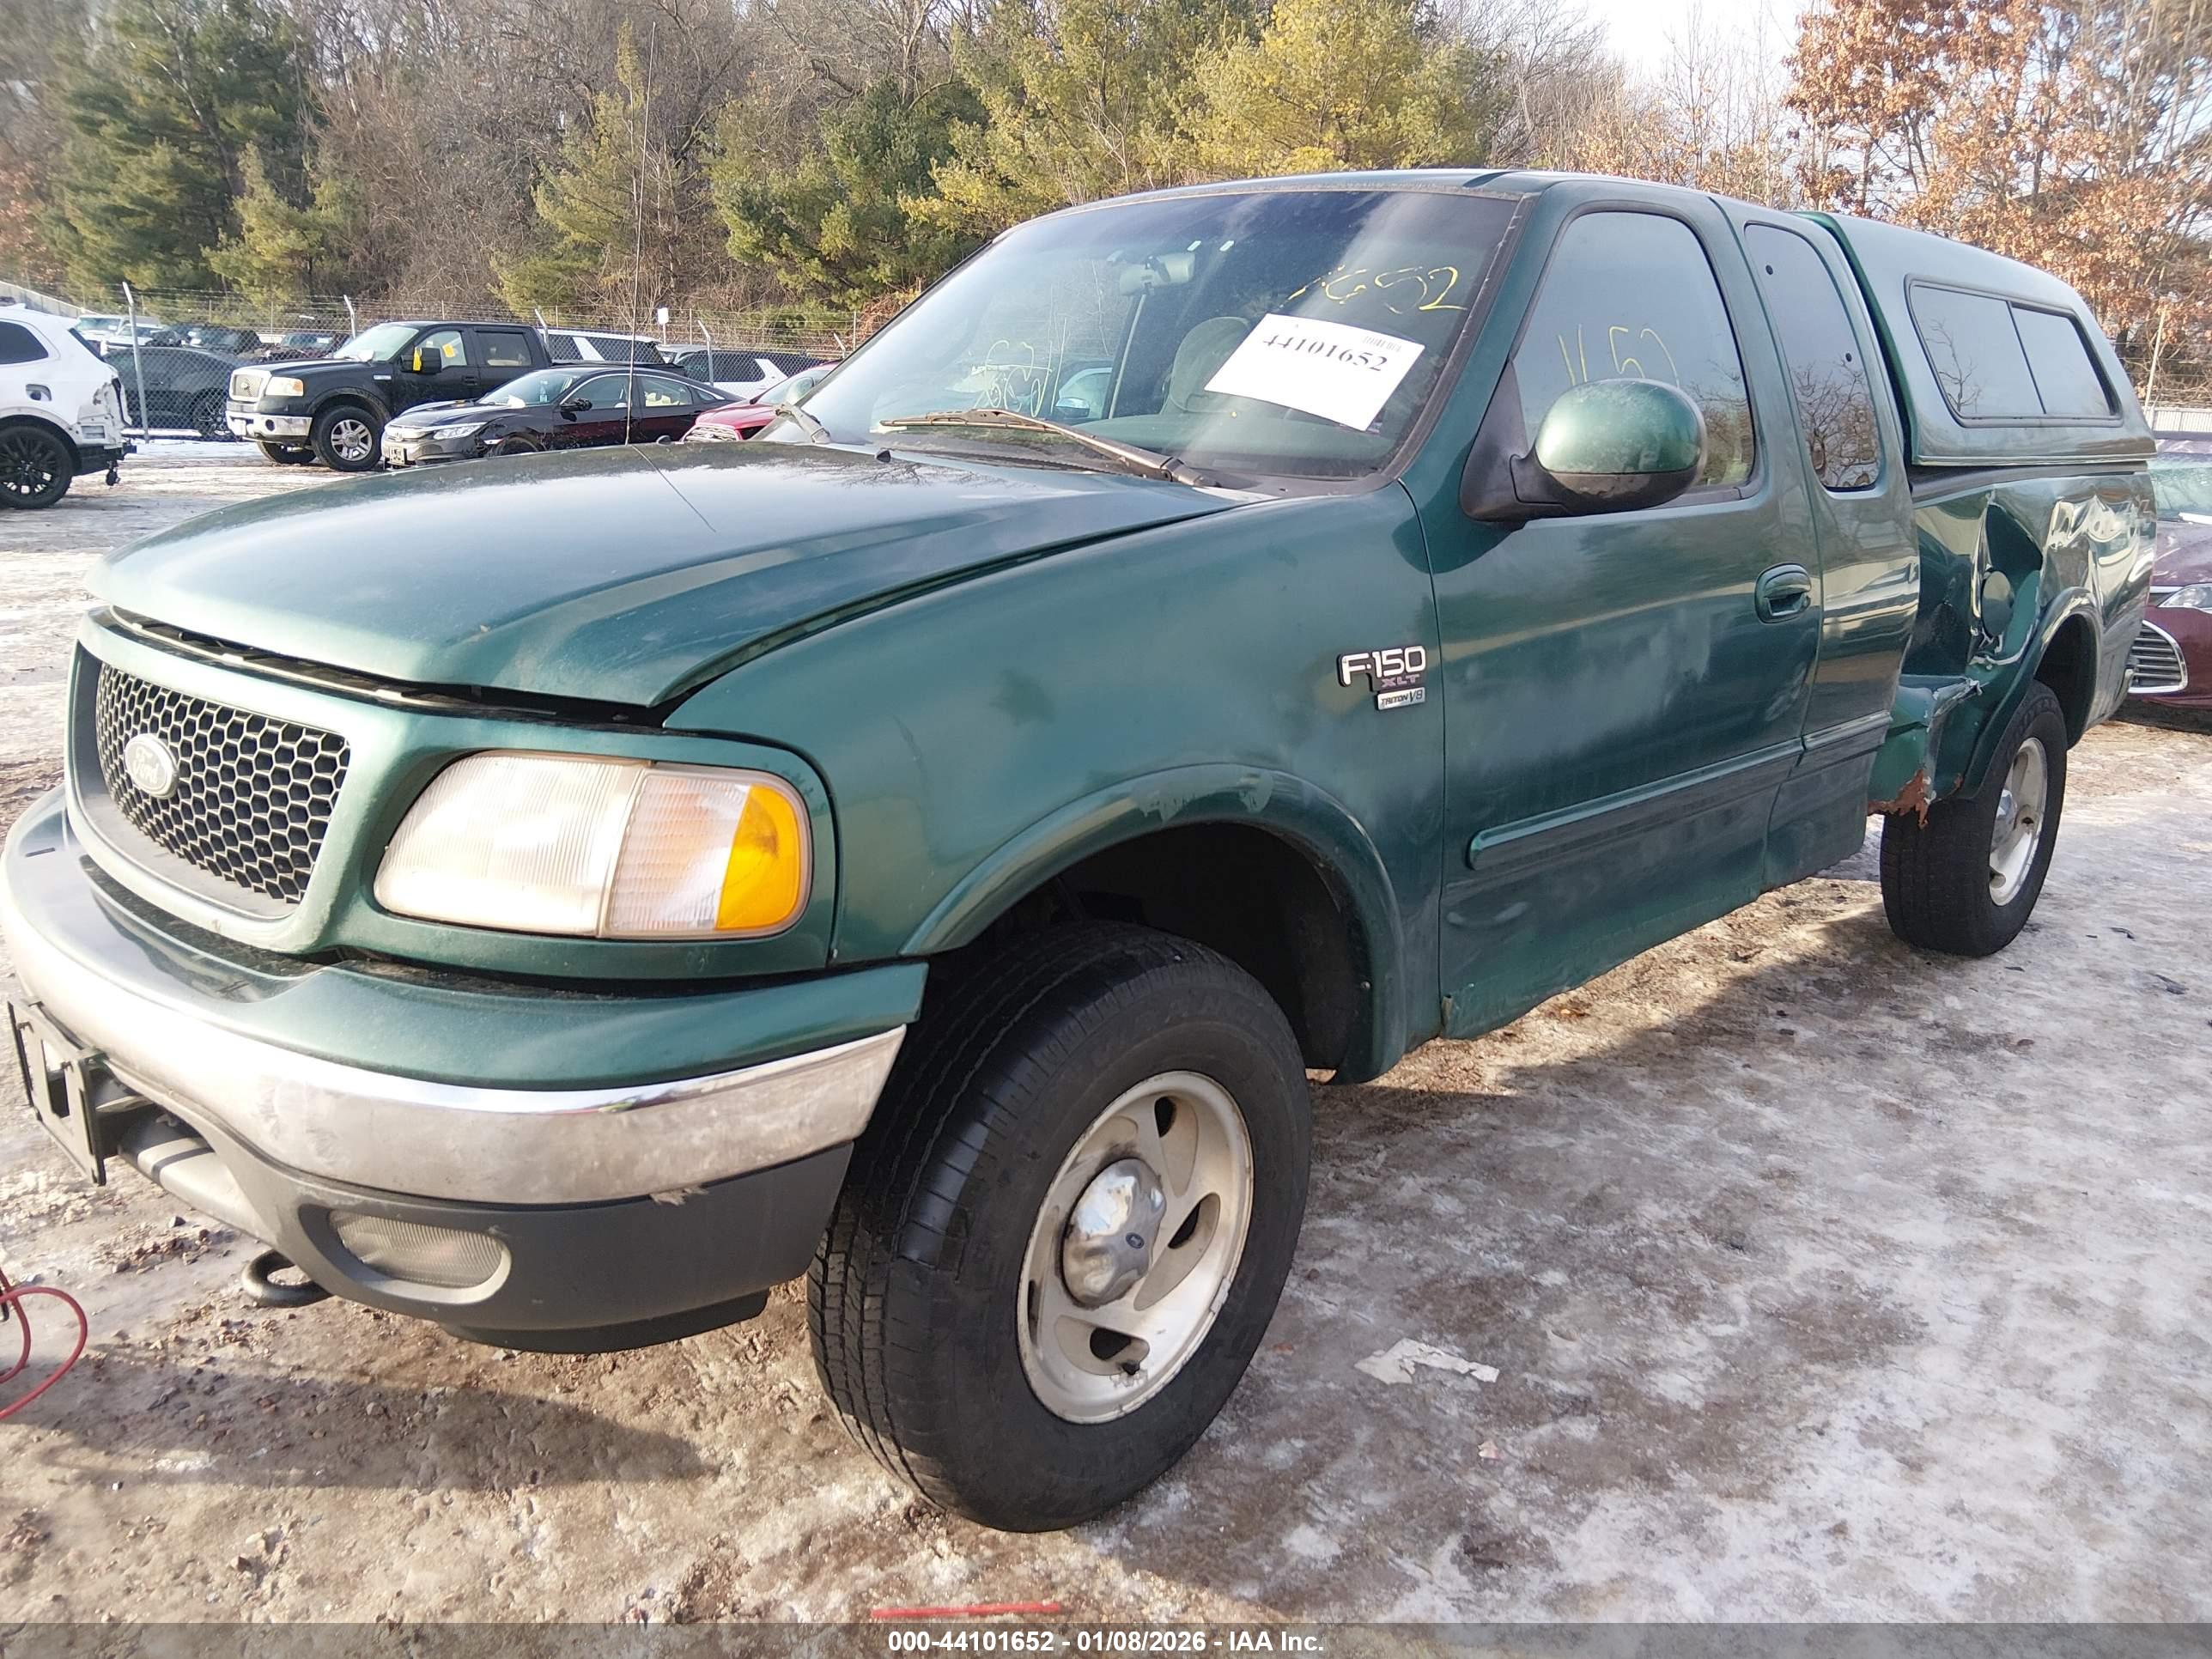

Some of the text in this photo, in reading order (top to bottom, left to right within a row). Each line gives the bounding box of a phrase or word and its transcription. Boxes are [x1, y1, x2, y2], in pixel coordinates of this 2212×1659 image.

[1263, 334, 1388, 372] 44101652
[1382, 674, 1420, 688] XLT
[1381, 690, 1423, 706] TRITON V8
